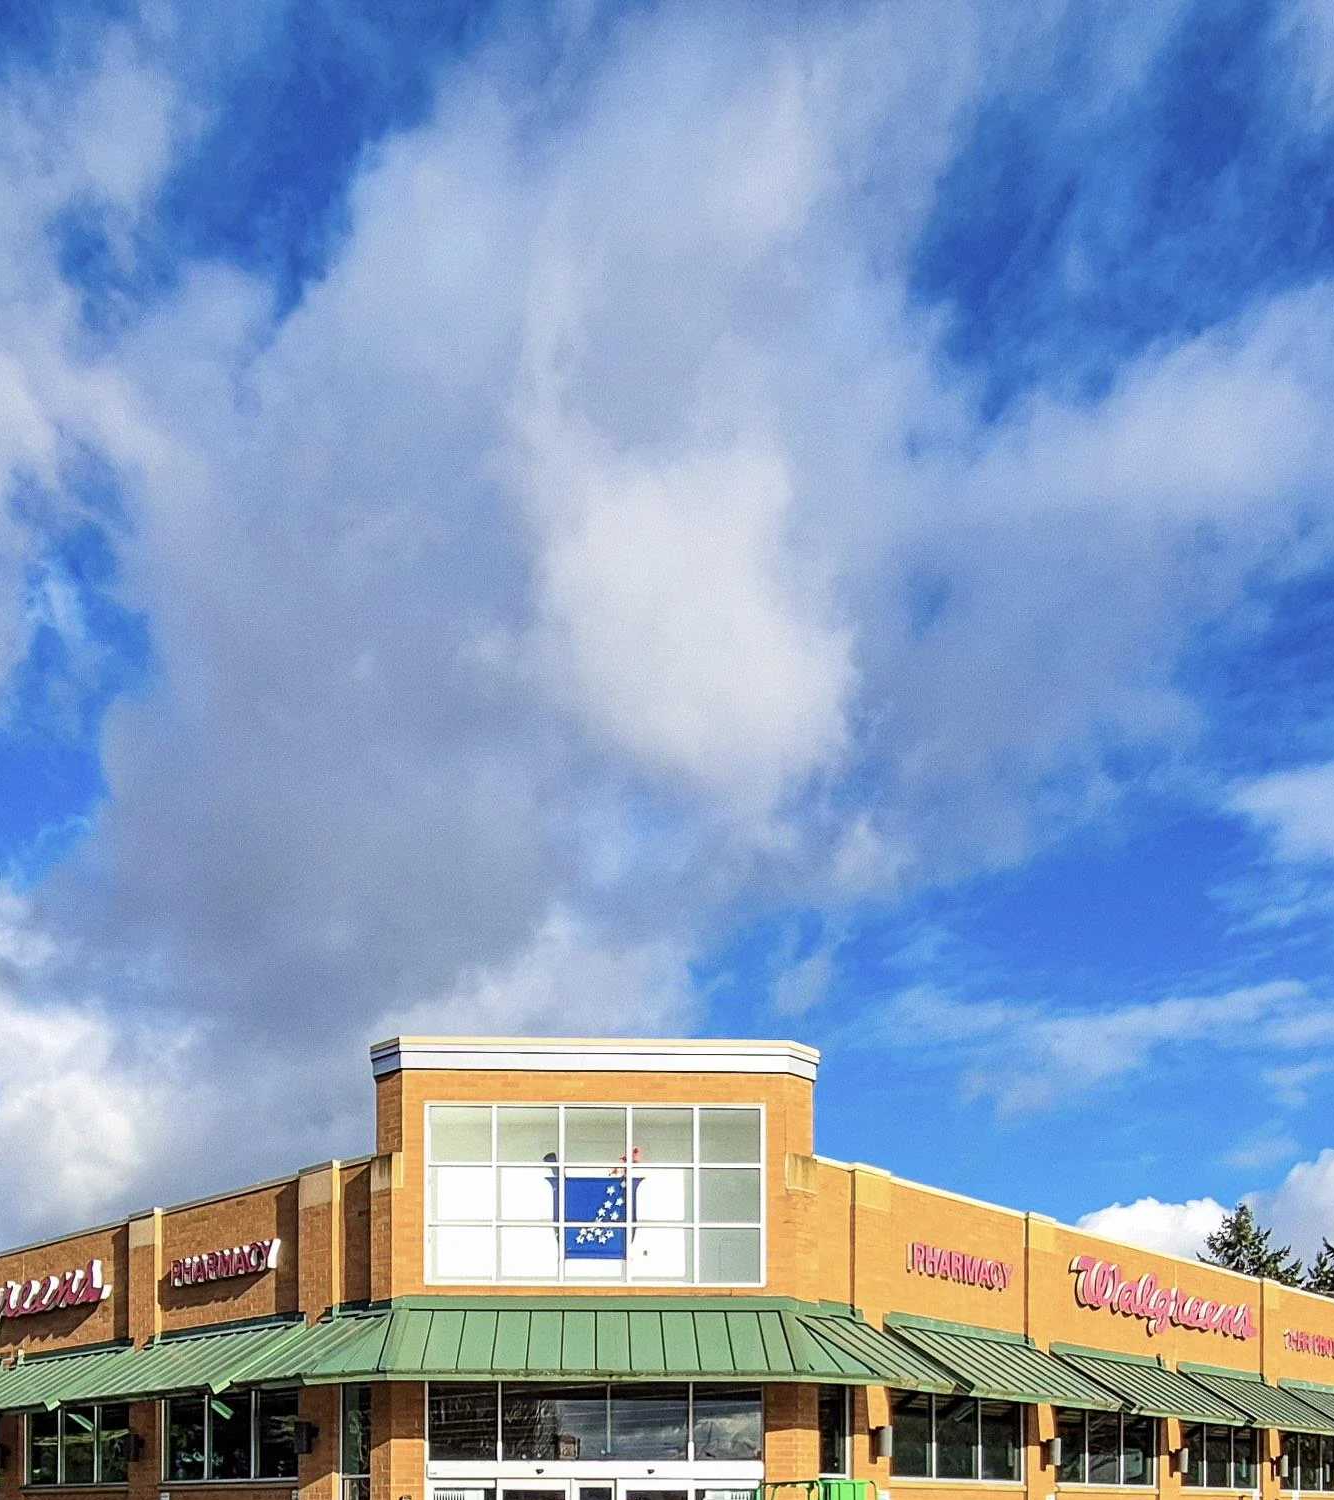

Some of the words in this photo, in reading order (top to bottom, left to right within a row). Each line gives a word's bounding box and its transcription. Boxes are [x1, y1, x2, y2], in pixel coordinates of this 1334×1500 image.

[171, 1238, 281, 1287] PHARMACY
[907, 1242, 1013, 1291] PHARMACY
[1069, 1256, 1257, 1339] Walgreens
